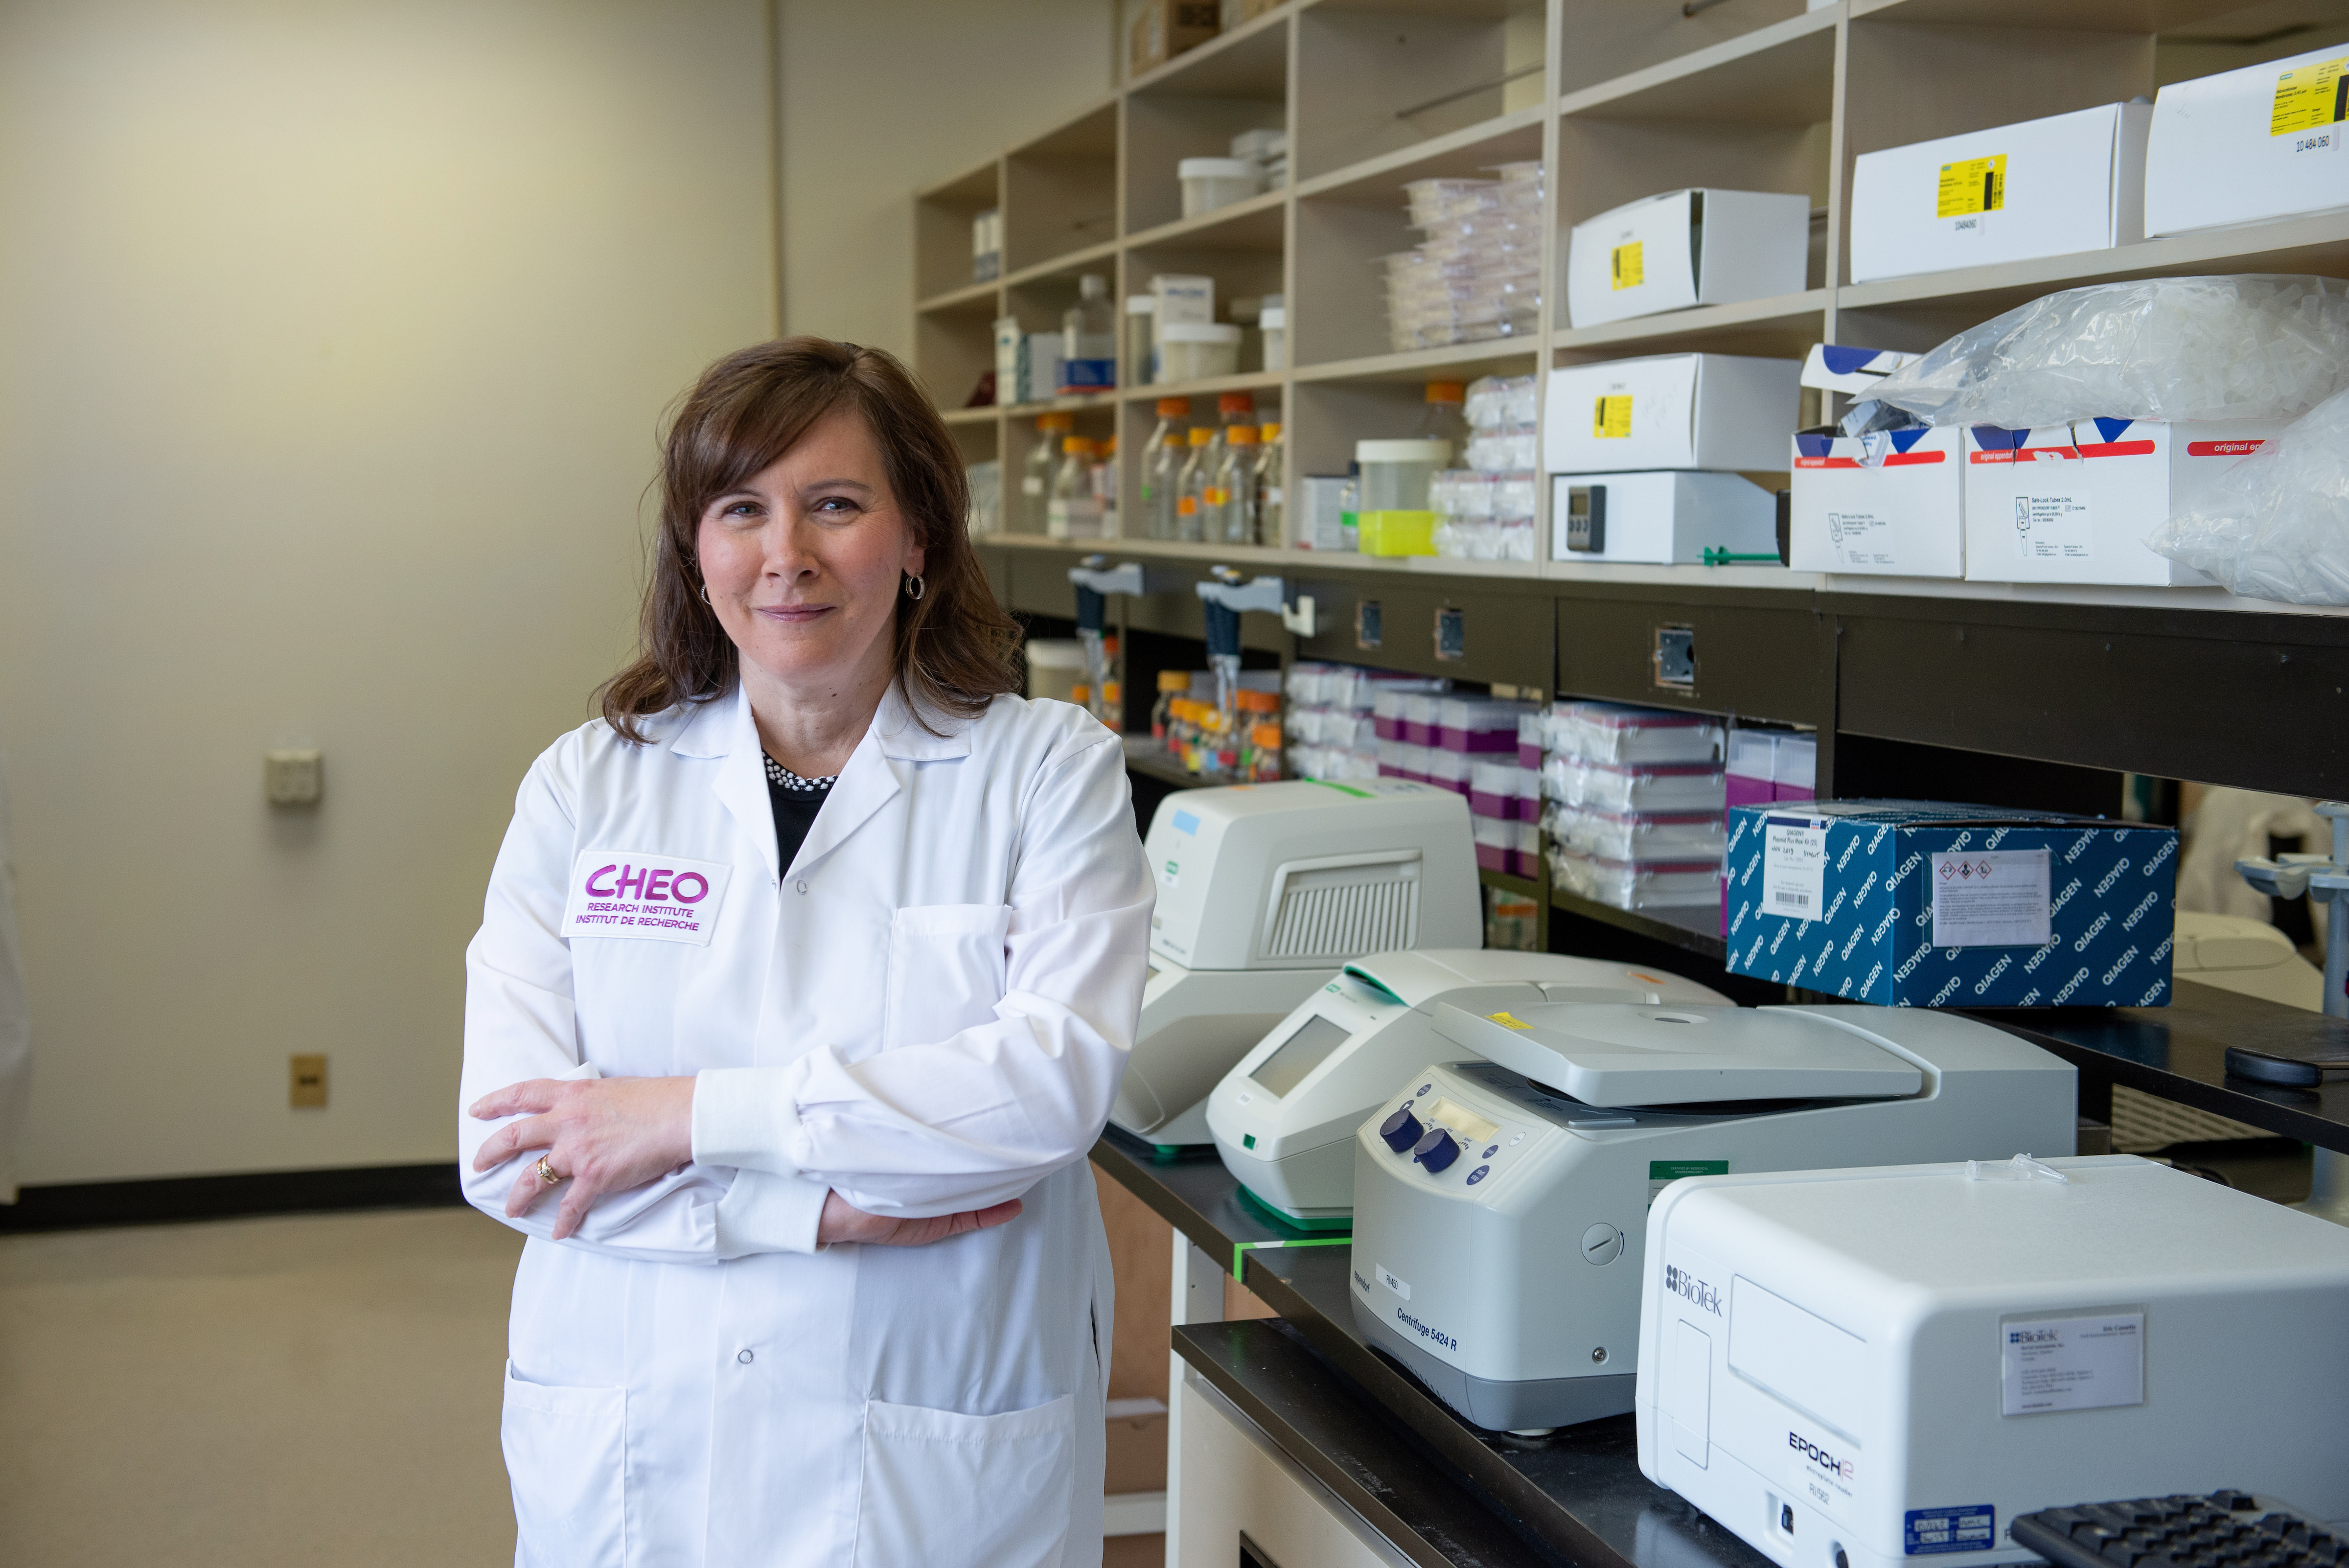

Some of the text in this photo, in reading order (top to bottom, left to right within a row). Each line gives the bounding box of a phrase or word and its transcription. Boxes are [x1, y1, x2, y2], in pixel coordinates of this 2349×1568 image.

[2296, 135, 2330, 152] 10 484 060
[1981, 453, 1994, 461] original
[2214, 442, 2248, 453] original
[1728, 817, 1748, 853] QIAGEN
[1836, 834, 1860, 873] QIAGEN
[1741, 850, 1761, 887] QIAGEN
[1885, 851, 1922, 892] QIAGEN
[2142, 836, 2179, 876] QIAGEN
[585, 864, 709, 904] CHEO
[1853, 871, 1877, 909] QIAGEN
[2094, 857, 2130, 898] QIAGEN
[576, 915, 700, 931] INSTITUT DE RECHERCHE
[587, 902, 694, 918] RESEARCH INSTITUTE
[1730, 900, 1749, 936] QIAGEN
[1824, 887, 1847, 925] QIAGEN
[2122, 891, 2158, 932] QIAGEN
[1770, 919, 1791, 955] QIAGEN
[1841, 923, 1865, 961] QIAGEN
[1871, 908, 1900, 946] QIAGEN
[2074, 911, 2111, 952] QIAGEN
[1744, 935, 1764, 970] QIAGEN
[1813, 940, 1834, 977] QIAGEN
[1893, 942, 1932, 983] QIAGEN
[2024, 933, 2061, 974] QIAGEN
[2102, 945, 2139, 986] QIAGEN
[1860, 961, 1883, 998] QIAGEN
[1975, 954, 2012, 995] QIAGEN
[1354, 1270, 1370, 1293] eppendorf
[1386, 1274, 1398, 1290] RI/450
[1679, 1270, 1722, 1317] BioTek
[1398, 1307, 1457, 1352] Centrifuge 5424 R
[2021, 1329, 2058, 1343] BioTek
[1806, 1465, 1834, 1486] microplate
